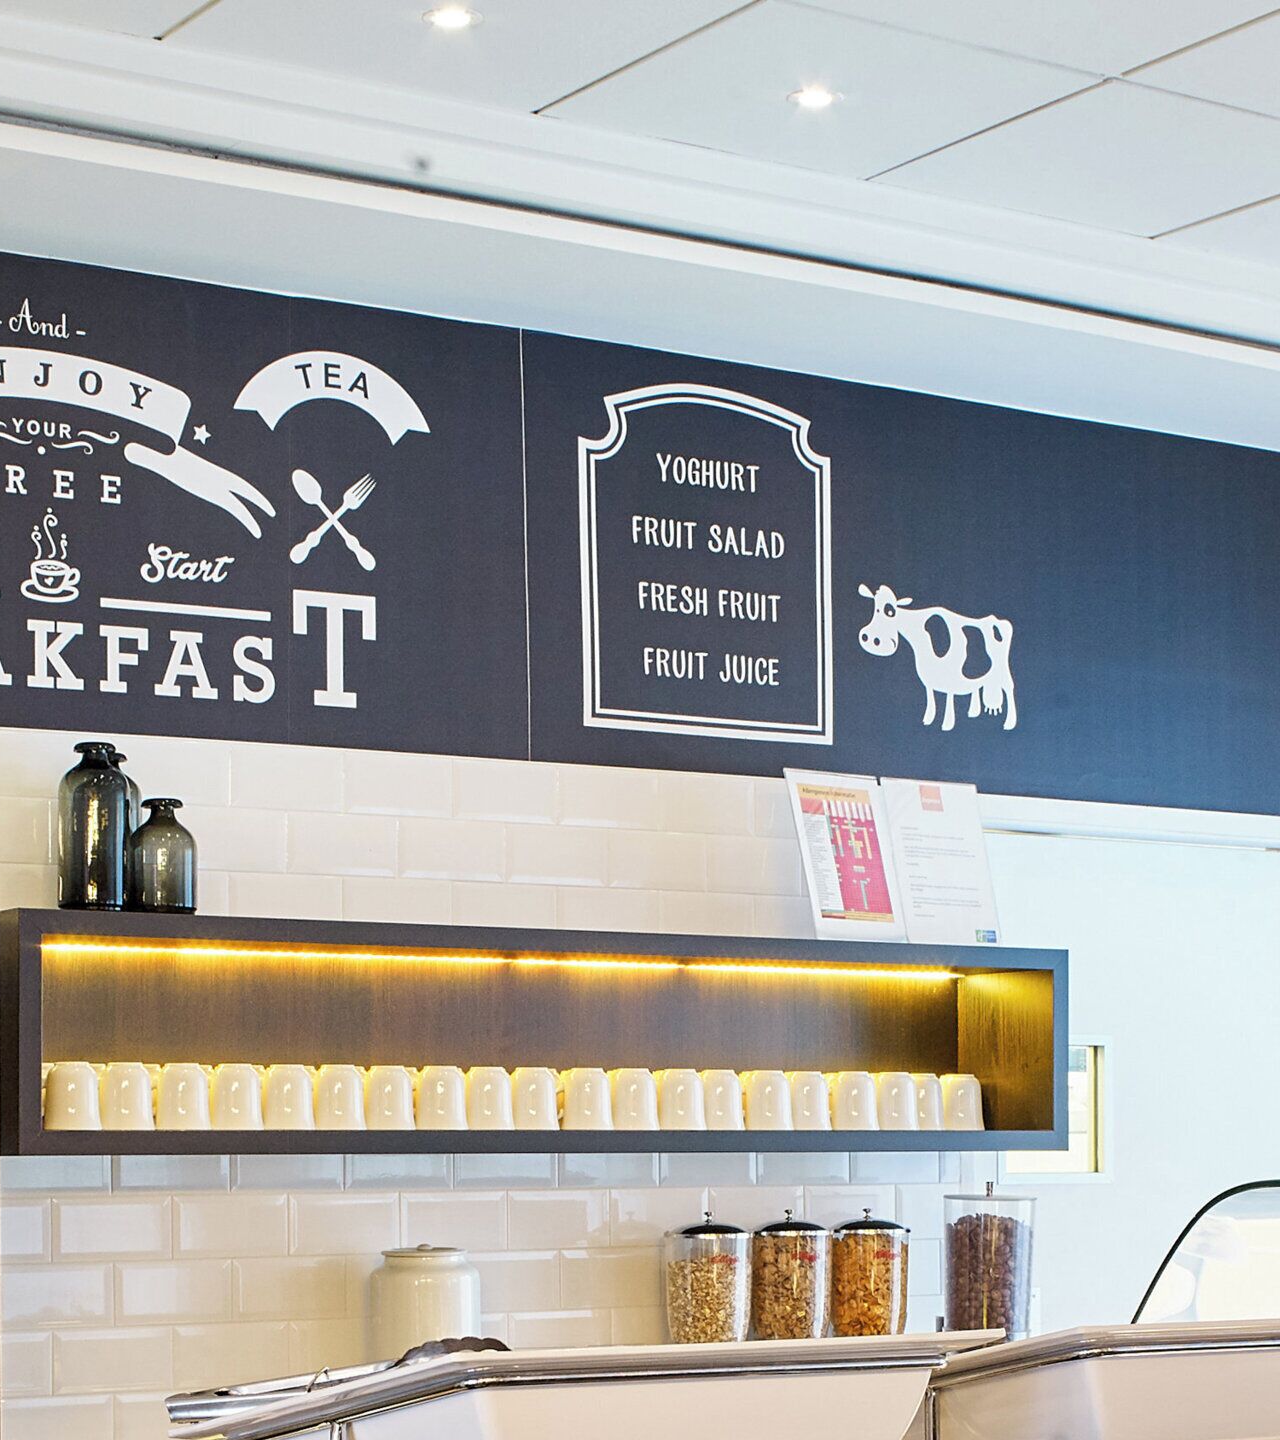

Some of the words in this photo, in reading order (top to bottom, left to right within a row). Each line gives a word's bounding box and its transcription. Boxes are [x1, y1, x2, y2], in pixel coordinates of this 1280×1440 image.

[8, 297, 70, 339] And
[294, 362, 369, 400] TEA
[11, 417, 72, 440] YOUR
[656, 452, 760, 493] YOGHURT
[632, 515, 698, 550] FRUIT
[707, 524, 785, 559] SALAD
[140, 542, 235, 584] Start
[638, 581, 708, 617] FRESH
[718, 589, 781, 623] FRUIT
[643, 647, 709, 681] FRUIT
[719, 653, 780, 686] JUICE
